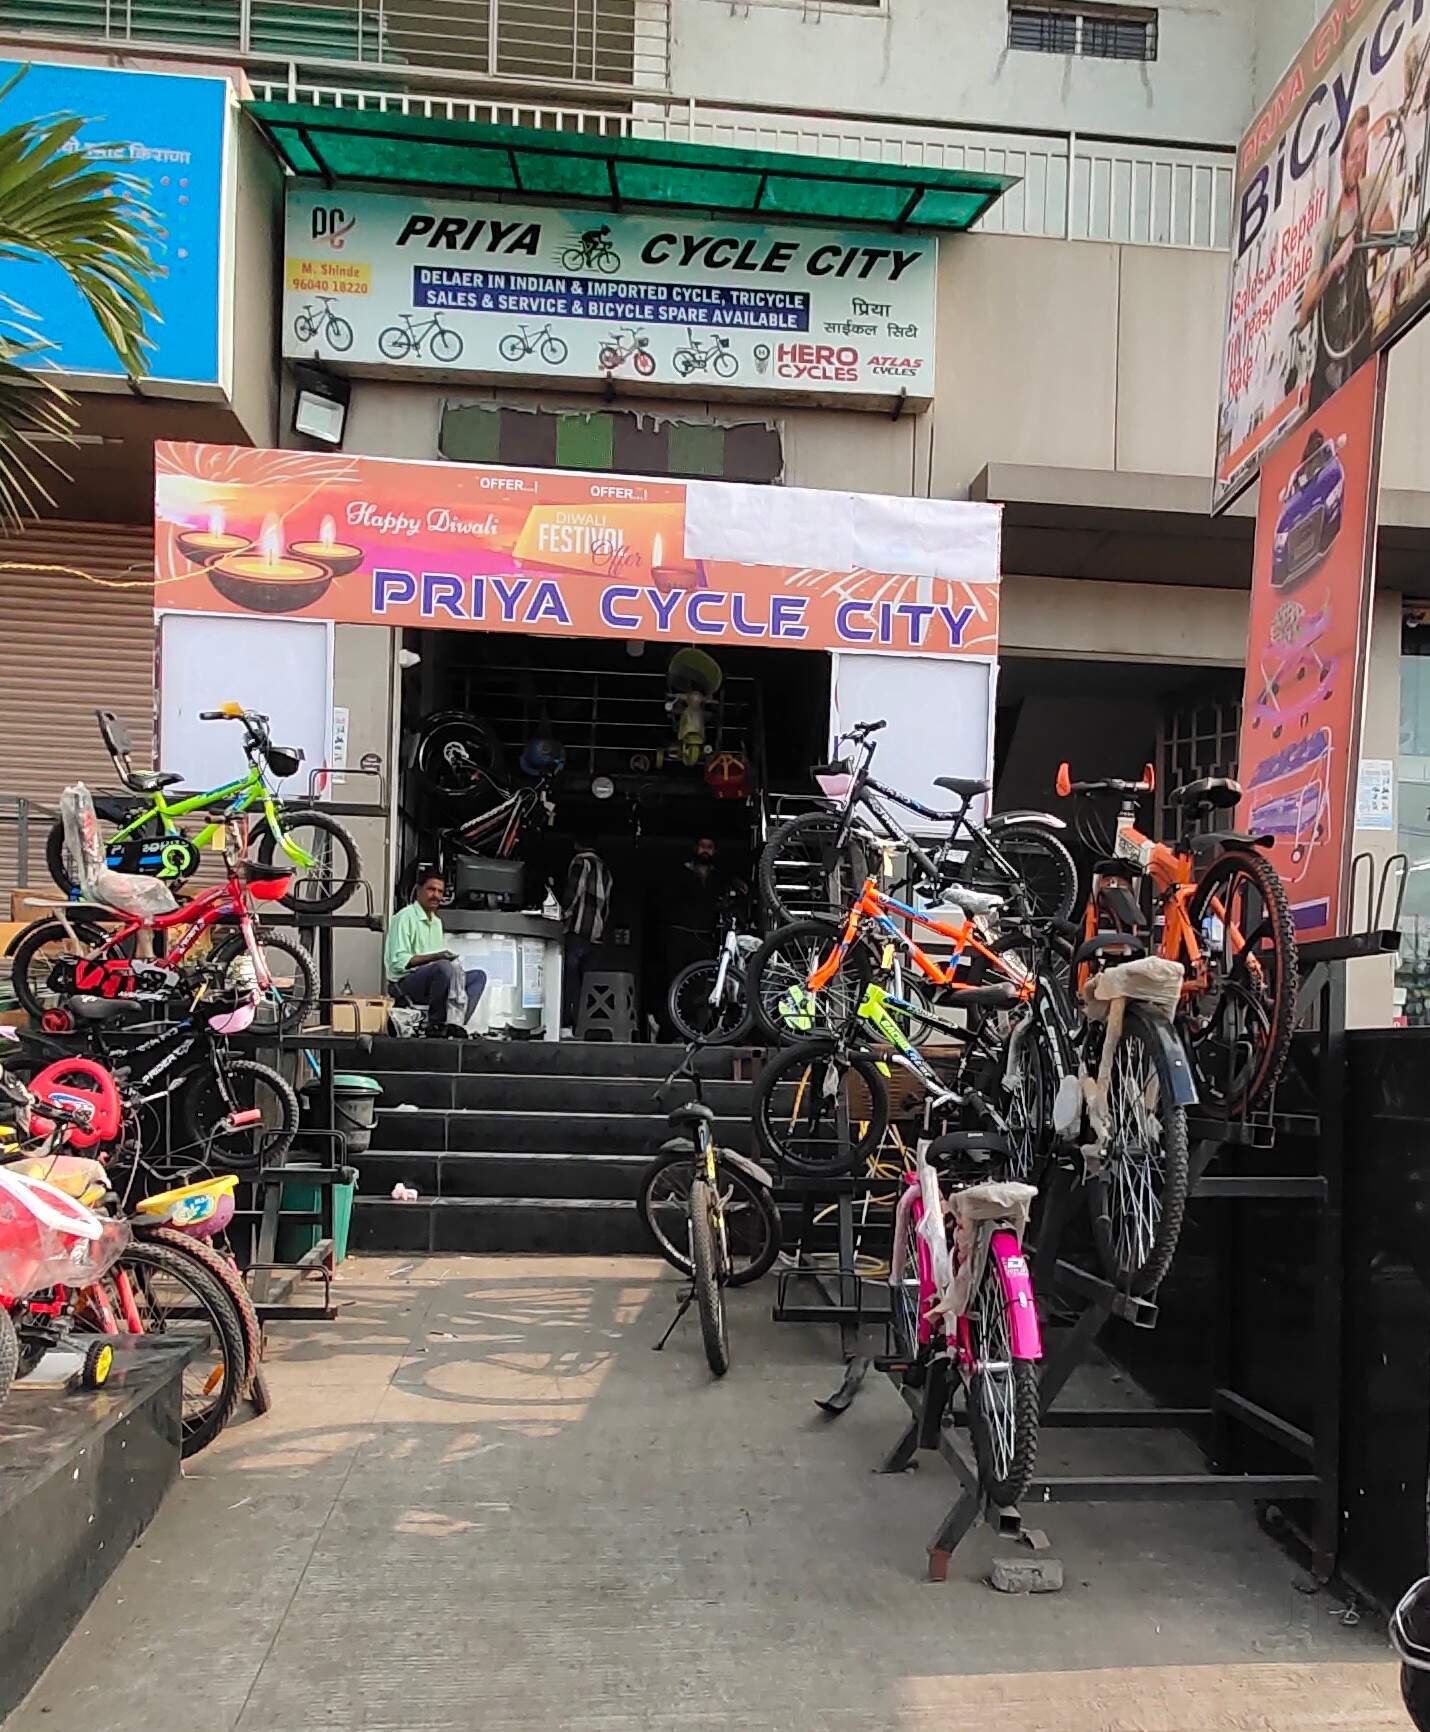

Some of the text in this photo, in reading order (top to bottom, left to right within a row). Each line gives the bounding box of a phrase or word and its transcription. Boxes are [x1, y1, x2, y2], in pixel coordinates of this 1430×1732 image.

[1281, 188, 1326, 260] Repair
[396, 214, 921, 281] PRIYA CYCLE CITY
[302, 262, 360, 278] M. Shinde
[292, 278, 328, 291] 96040
[420, 269, 804, 309] DELAER IN INDIAN & IMPORTED CYCLE, TRICYCLE
[1243, 247, 1313, 341] reasonable
[427, 290, 798, 328] SALES & SERVICE & BICYCLE SPARE AVAILABLE
[852, 297, 893, 318] प्रिया
[823, 319, 918, 338] साईकल सिटी
[777, 343, 858, 366] HERO
[867, 356, 923, 368] ATLAS
[777, 364, 858, 382] CYCLES
[872, 367, 917, 377] CYCLES
[1228, 355, 1254, 398] Rate
[345, 501, 499, 536] Happy Diwali
[555, 511, 607, 527] DIWALI
[372, 568, 978, 648] PRIYA CYCLE CITY
